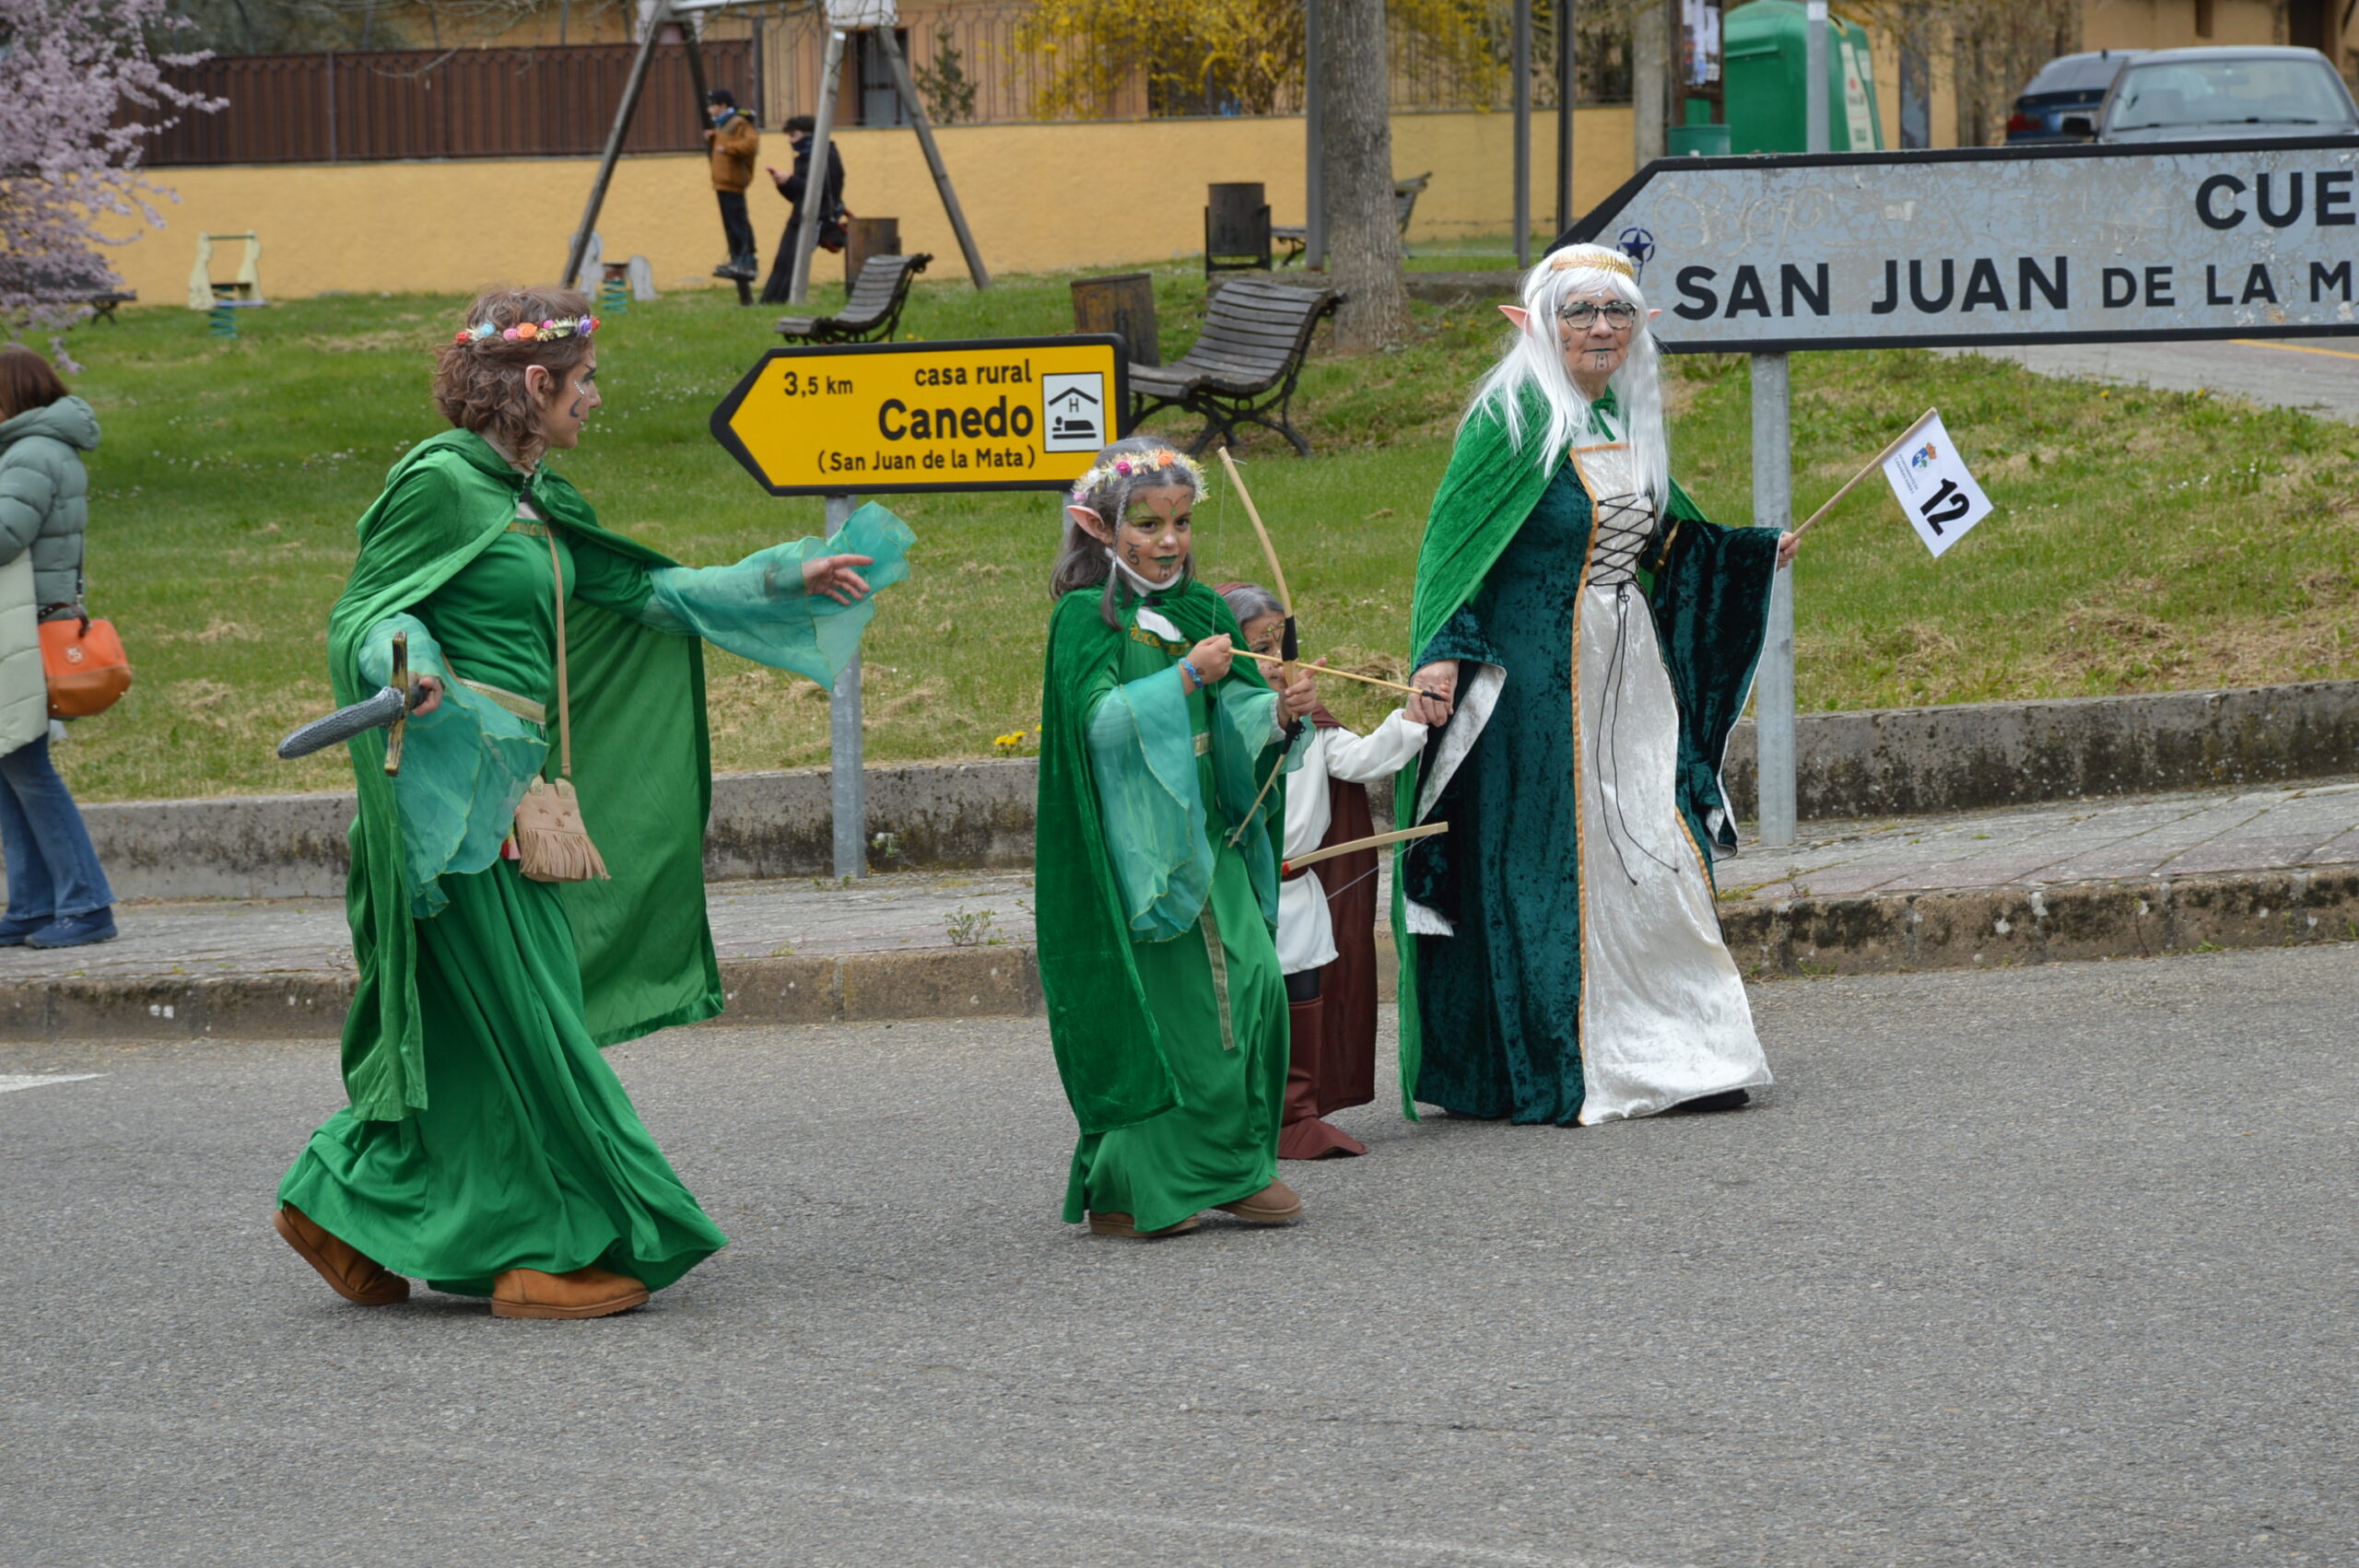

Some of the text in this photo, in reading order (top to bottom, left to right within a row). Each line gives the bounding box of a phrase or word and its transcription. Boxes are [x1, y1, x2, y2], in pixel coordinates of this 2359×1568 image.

[1672, 263, 1830, 321] SAN
[1872, 256, 2069, 315] JUAN
[2102, 266, 2175, 309] DE
[2206, 263, 2278, 306] LA
[783, 371, 853, 397] 3,5 km
[914, 358, 1033, 387] casa rural
[878, 395, 1035, 441] Canedo
[817, 445, 1036, 474] (San Juan de la Mata)
[1919, 477, 1970, 537] 12
